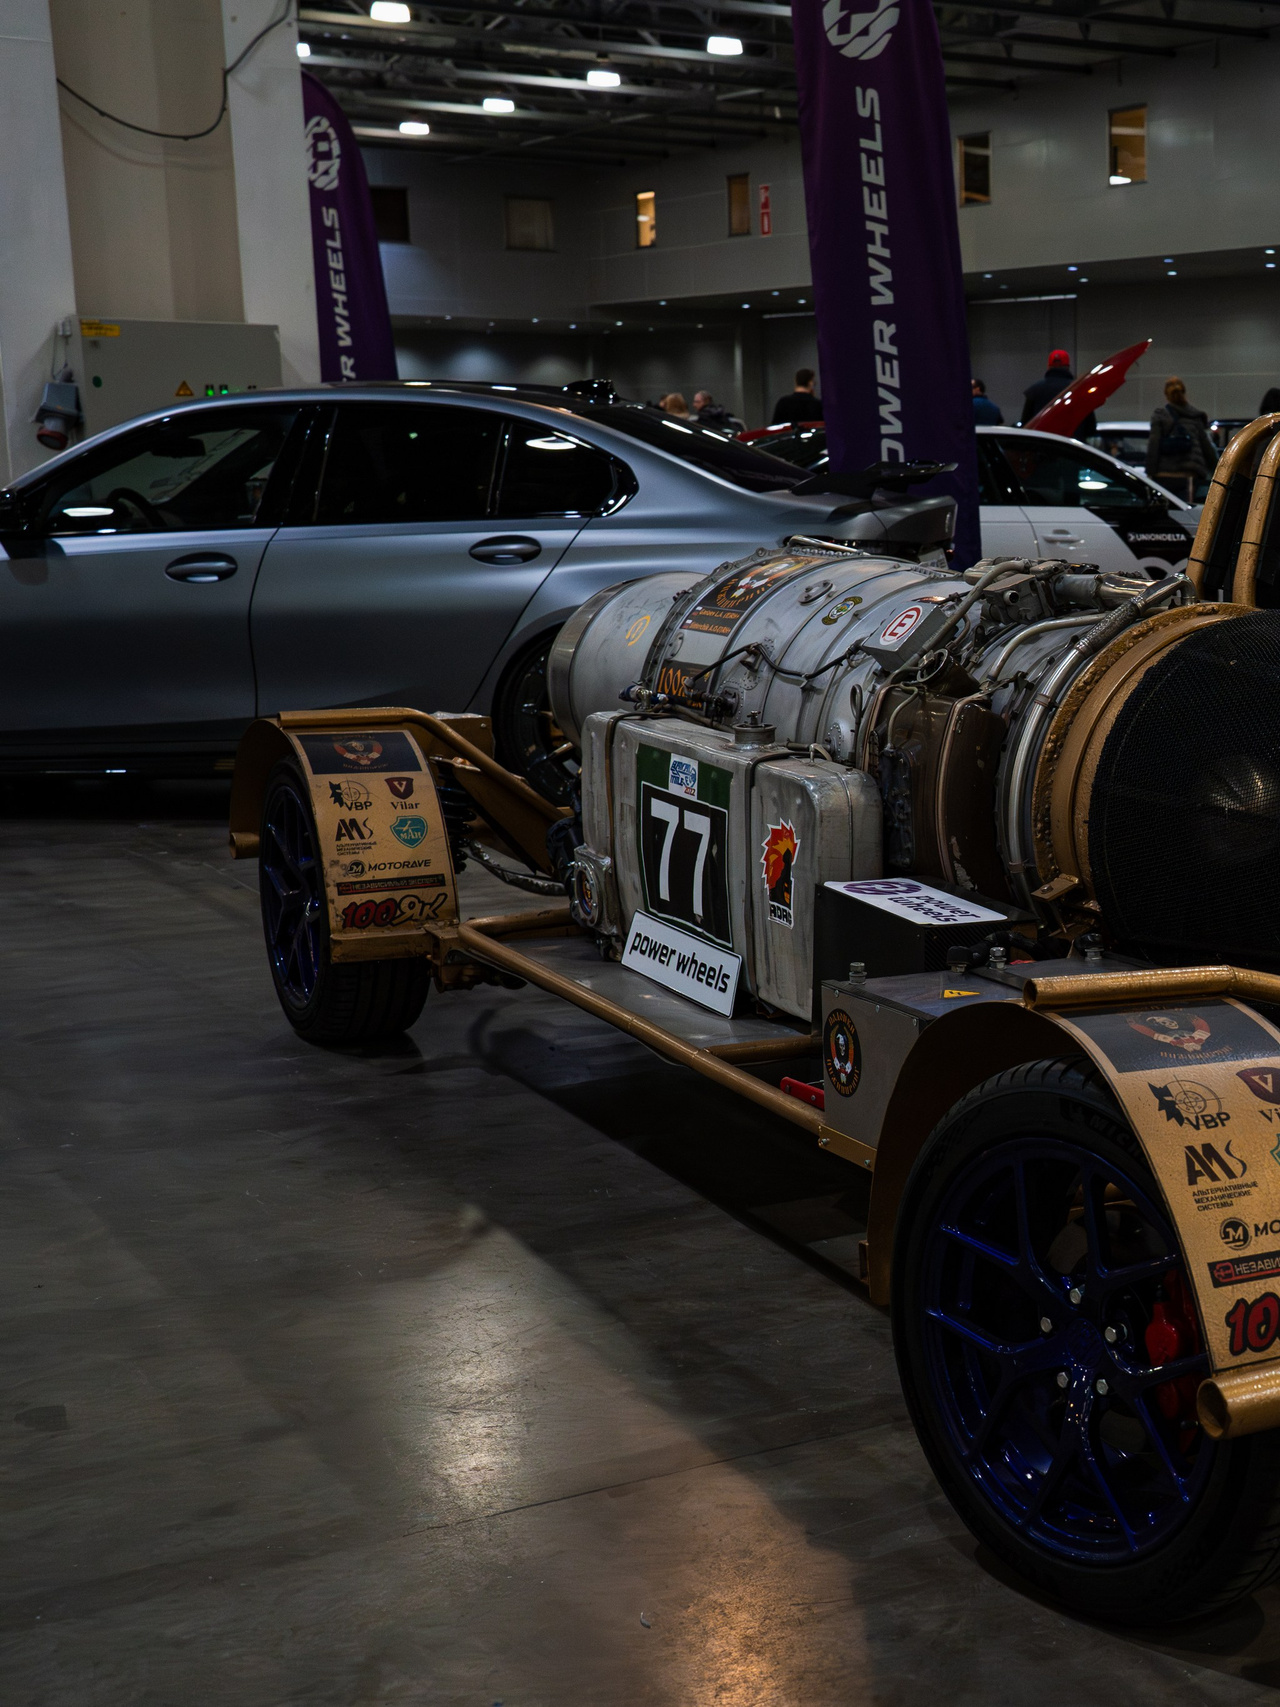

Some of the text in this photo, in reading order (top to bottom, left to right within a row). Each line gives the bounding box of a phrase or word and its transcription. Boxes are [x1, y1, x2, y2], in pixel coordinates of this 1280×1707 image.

[322, 205, 353, 348] WHEELS
[855, 85, 905, 463] OWER WHEELS
[889, 613, 914, 637] E
[342, 801, 373, 811] VBP
[390, 801, 420, 811] Vilar
[368, 859, 431, 872] MOTORAVE
[651, 797, 711, 917] 77
[887, 896, 959, 922] wheels
[907, 895, 981, 918] power
[631, 931, 730, 994] power wheels
[1184, 1112, 1231, 1130] VBP
[1192, 1181, 1259, 1197] АЛЬТЕРНАТИВНЫЕ
[1194, 1189, 1254, 1205] МЕХАНИЧЕСКИЕ
[1197, 1200, 1234, 1212] СИСТЕМЫ
